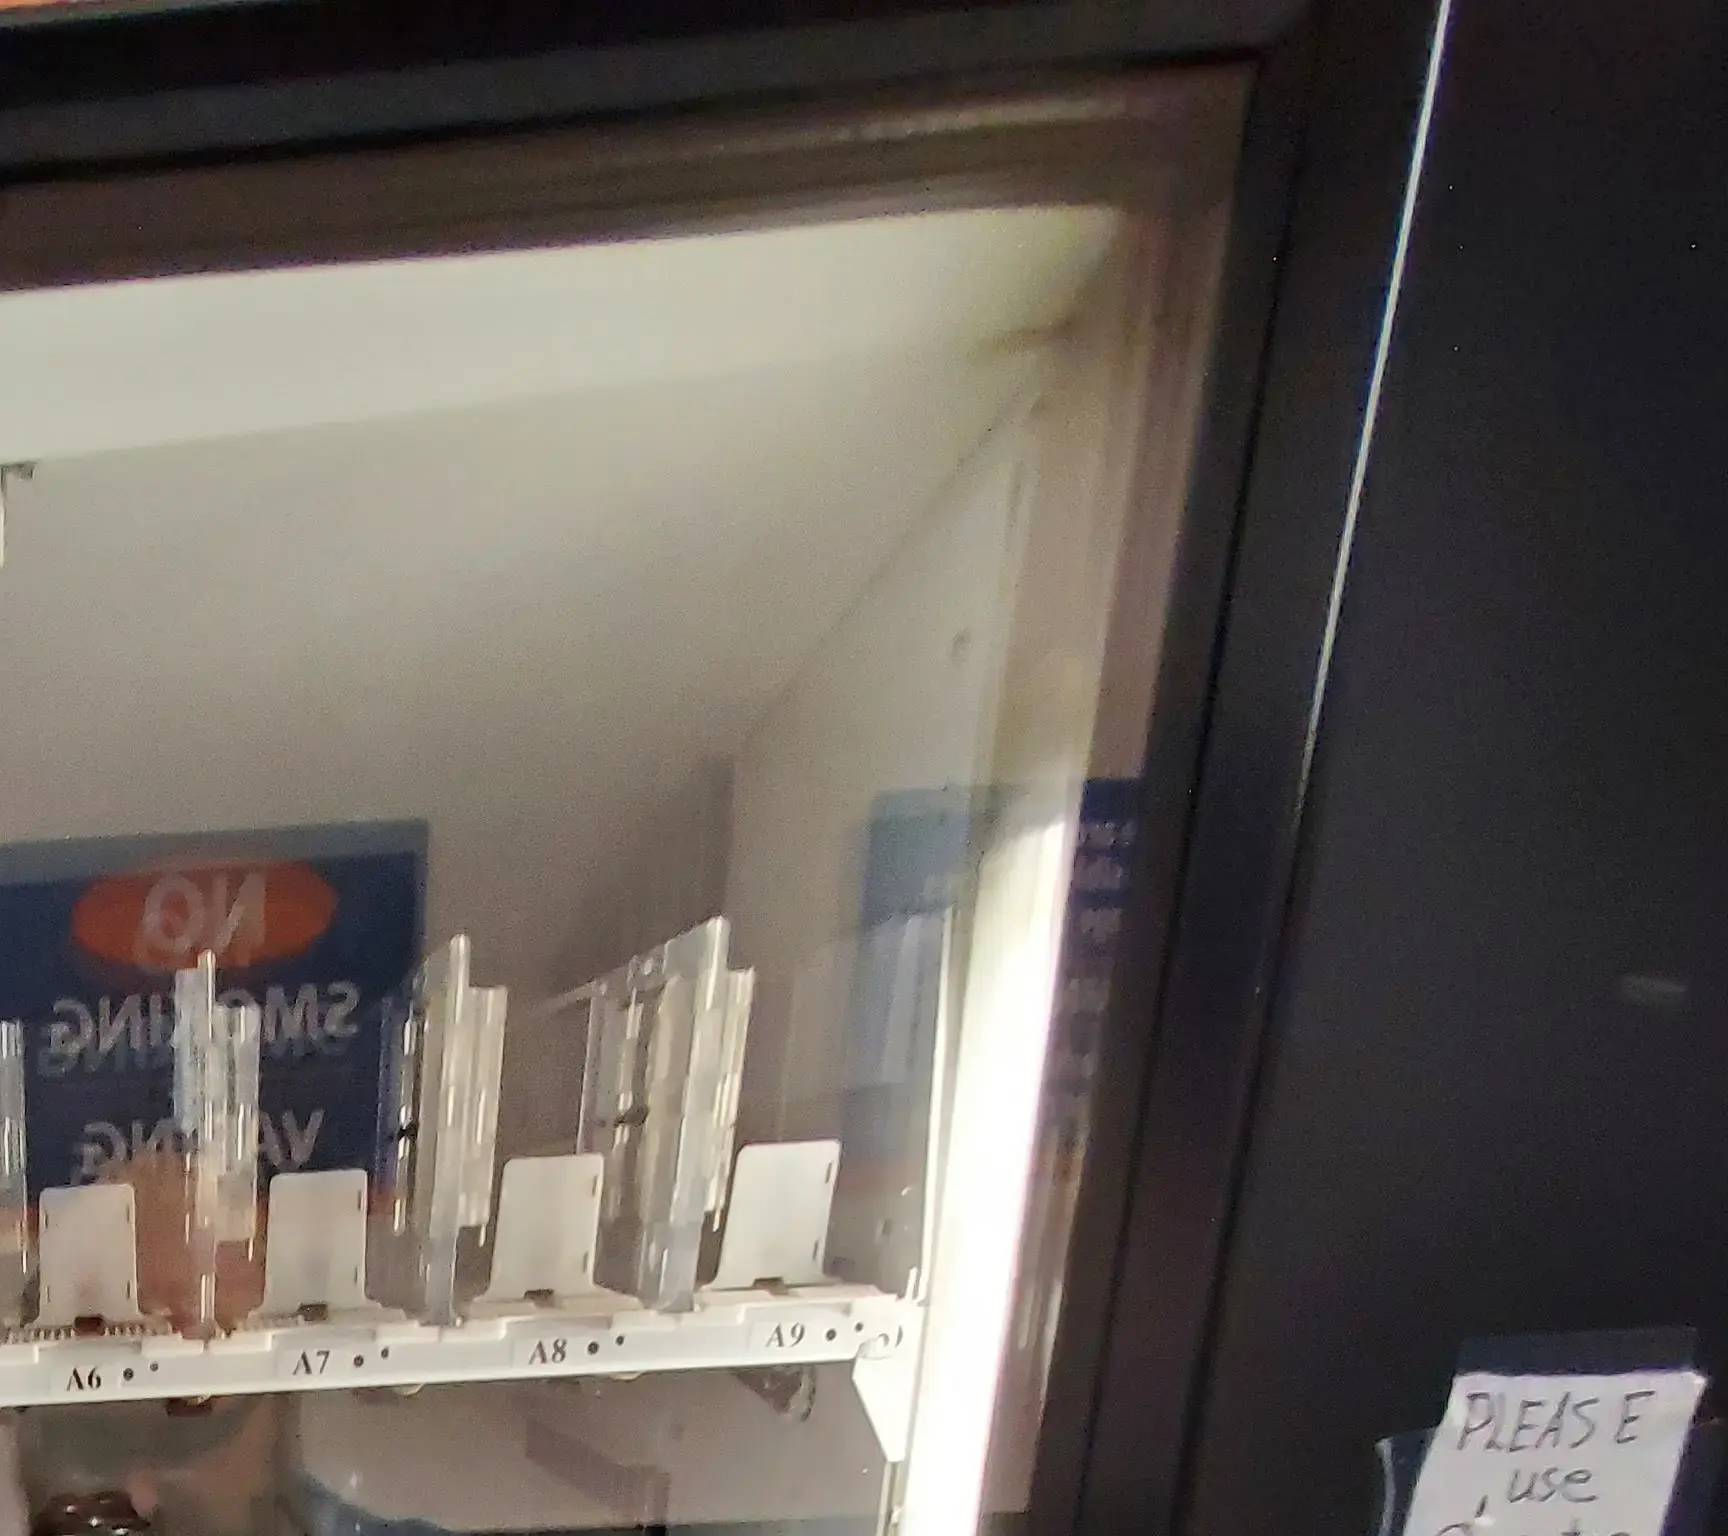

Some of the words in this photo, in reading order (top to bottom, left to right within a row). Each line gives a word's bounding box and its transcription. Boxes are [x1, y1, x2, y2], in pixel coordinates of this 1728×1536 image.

[66, 1367, 102, 1393] A6
[292, 1350, 331, 1376] A7
[528, 1339, 567, 1366] A8
[766, 1323, 806, 1349] A9
[1456, 1390, 1656, 1452] PLEASE
[1506, 1467, 1598, 1504] use
